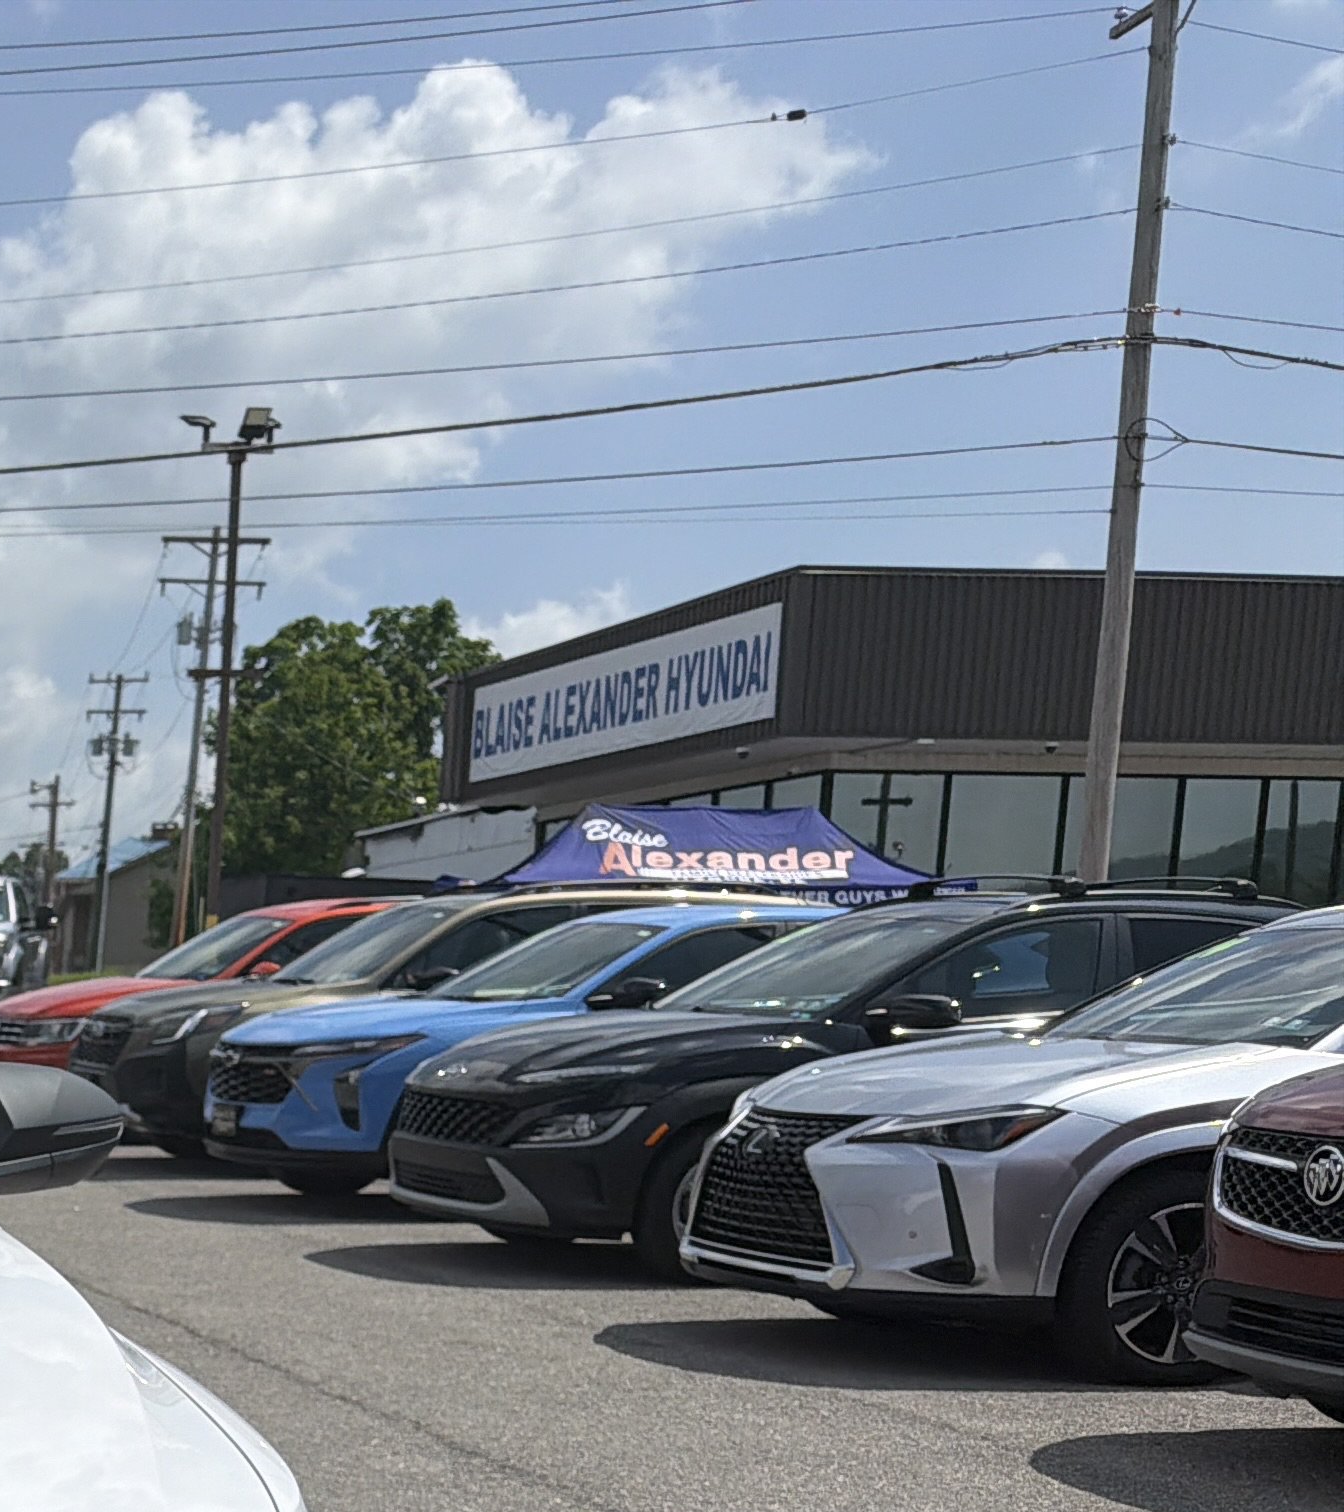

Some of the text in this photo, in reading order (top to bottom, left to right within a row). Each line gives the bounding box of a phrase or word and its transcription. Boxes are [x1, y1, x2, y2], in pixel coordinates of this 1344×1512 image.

[474, 631, 773, 759] BLAISE ALEXANDER HYUNDAI
[582, 818, 669, 848] Blaise
[599, 841, 855, 877] Alexander
